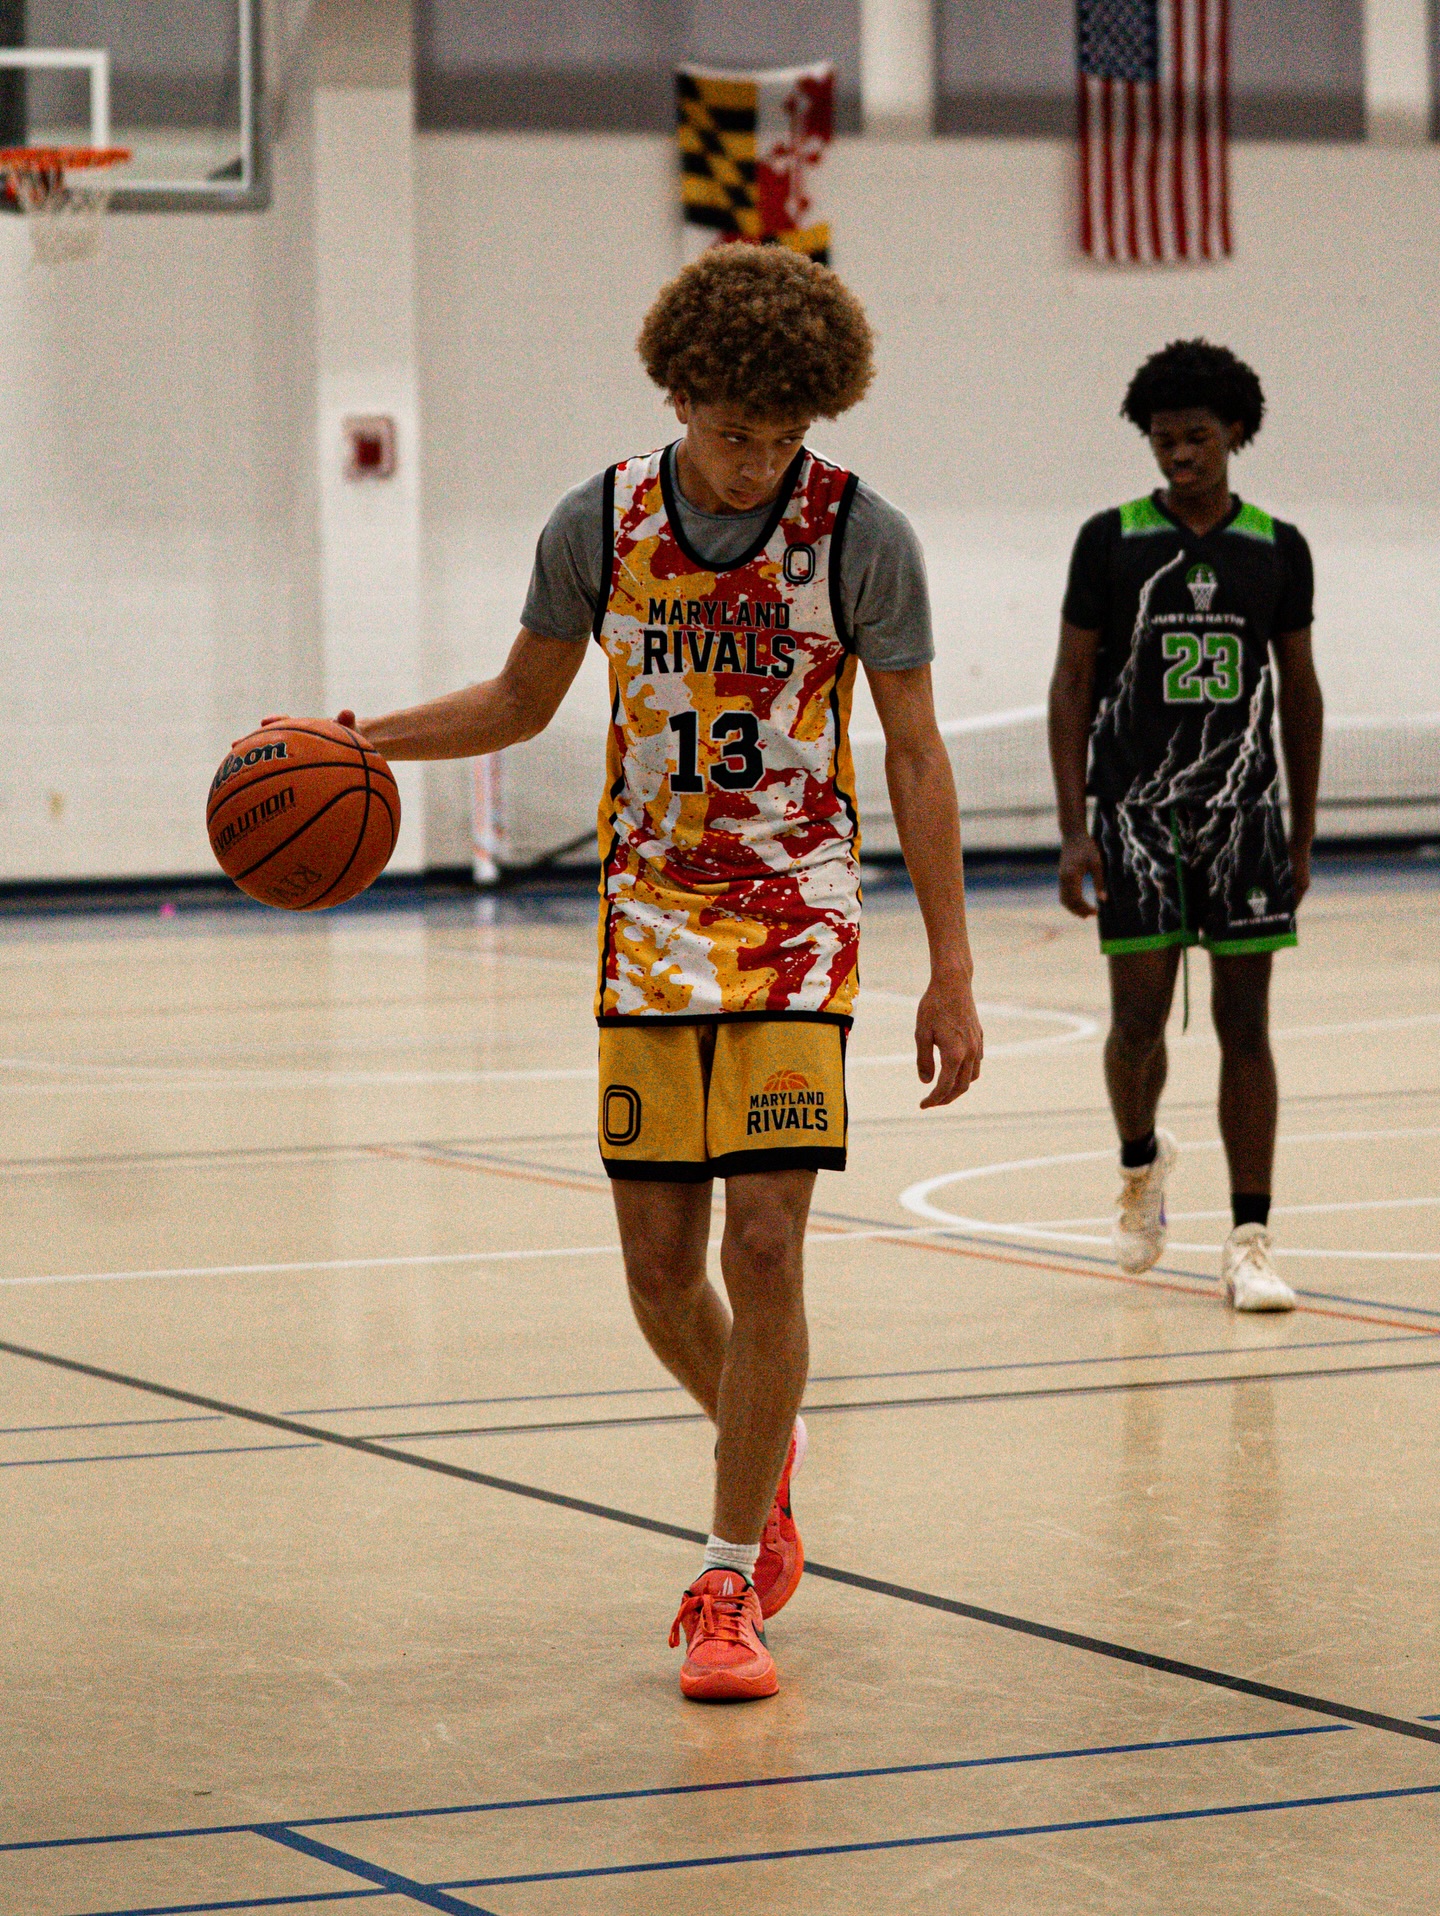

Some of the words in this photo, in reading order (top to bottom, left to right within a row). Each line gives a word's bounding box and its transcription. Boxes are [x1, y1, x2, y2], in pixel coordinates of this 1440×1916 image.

[647, 597, 790, 630] MARYLAND
[642, 629, 796, 679] RIVALS
[1162, 632, 1243, 704] 23
[668, 710, 766, 793] 13
[750, 1091, 825, 1109] MARYLAND
[746, 1108, 828, 1136] RIVALS
